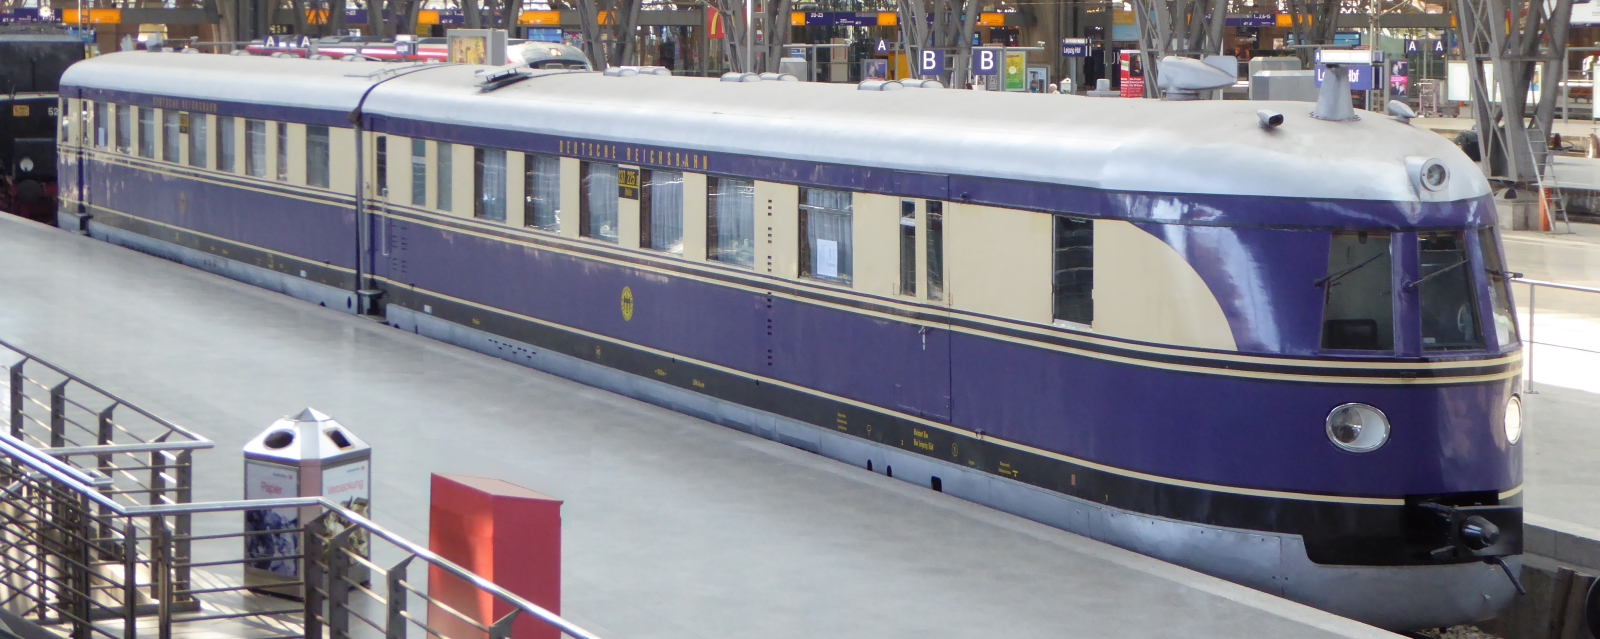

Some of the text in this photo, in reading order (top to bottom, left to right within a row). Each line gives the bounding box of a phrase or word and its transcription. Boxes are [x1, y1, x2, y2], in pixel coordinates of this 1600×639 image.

[265, 35, 276, 48] A
[300, 35, 311, 48] A
[877, 39, 887, 51] A
[1408, 42, 1417, 51] A
[1435, 42, 1444, 51] A
[923, 50, 936, 70] B
[981, 50, 994, 70] B
[559, 140, 708, 170] DEUTSCHE REICHSBAHN
[260, 481, 283, 496] Papier
[327, 479, 364, 495] Verpackung
